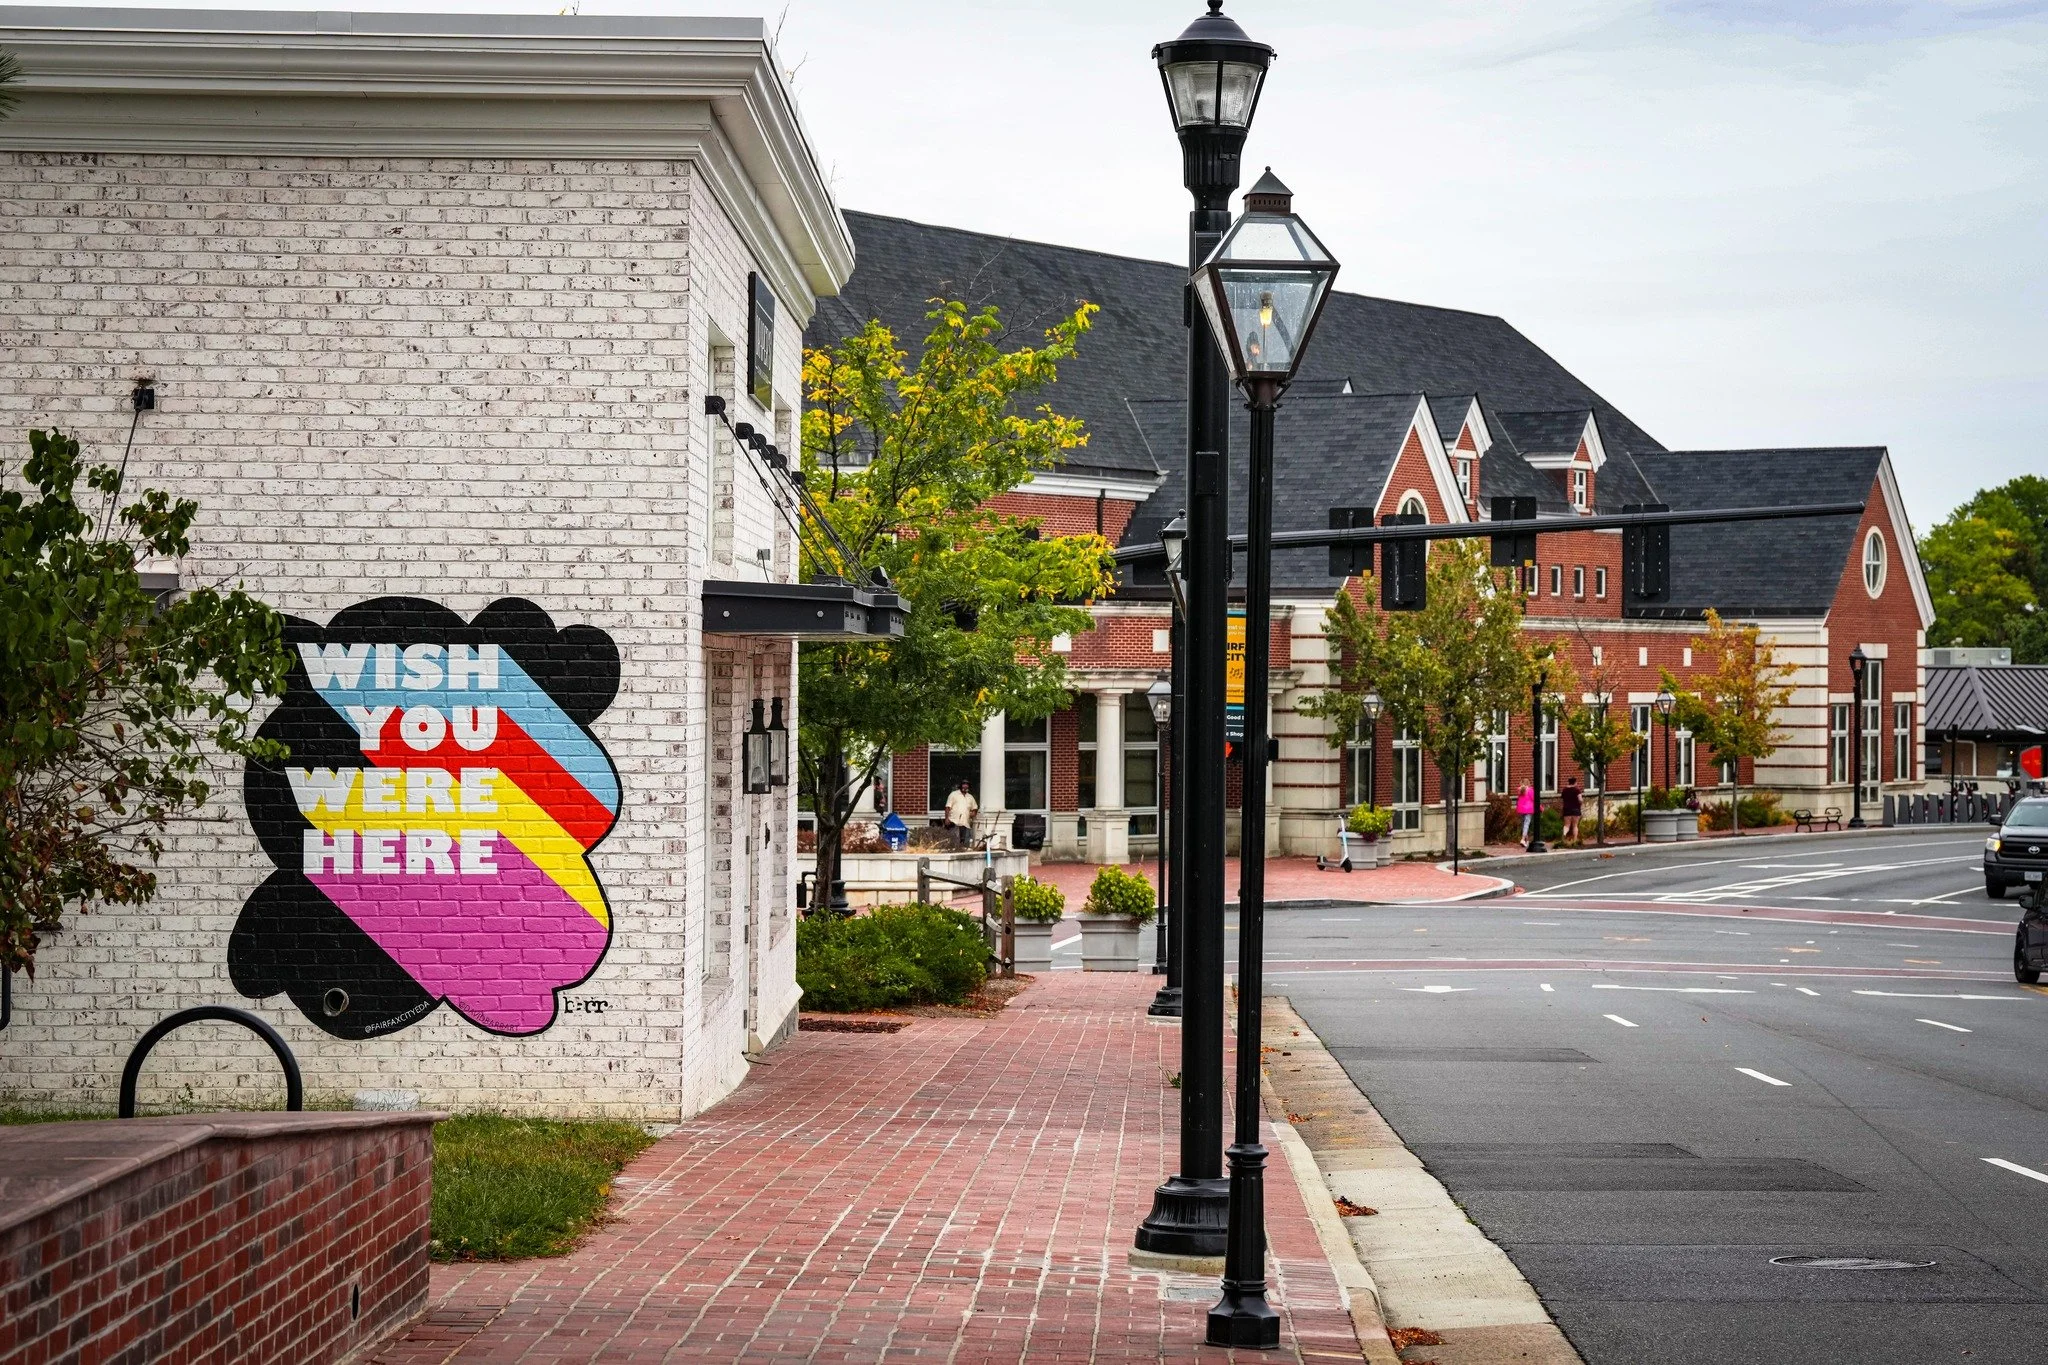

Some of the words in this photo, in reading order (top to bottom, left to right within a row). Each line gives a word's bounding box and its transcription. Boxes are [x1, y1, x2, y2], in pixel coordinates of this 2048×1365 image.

[296, 642, 499, 690] WISH
[1227, 642, 1246, 651] IRF
[344, 704, 498, 752] YOU
[285, 767, 499, 813] WERE
[303, 829, 499, 875] HERE
[364, 1000, 431, 1034] @FAIRFAXCITYEDA
